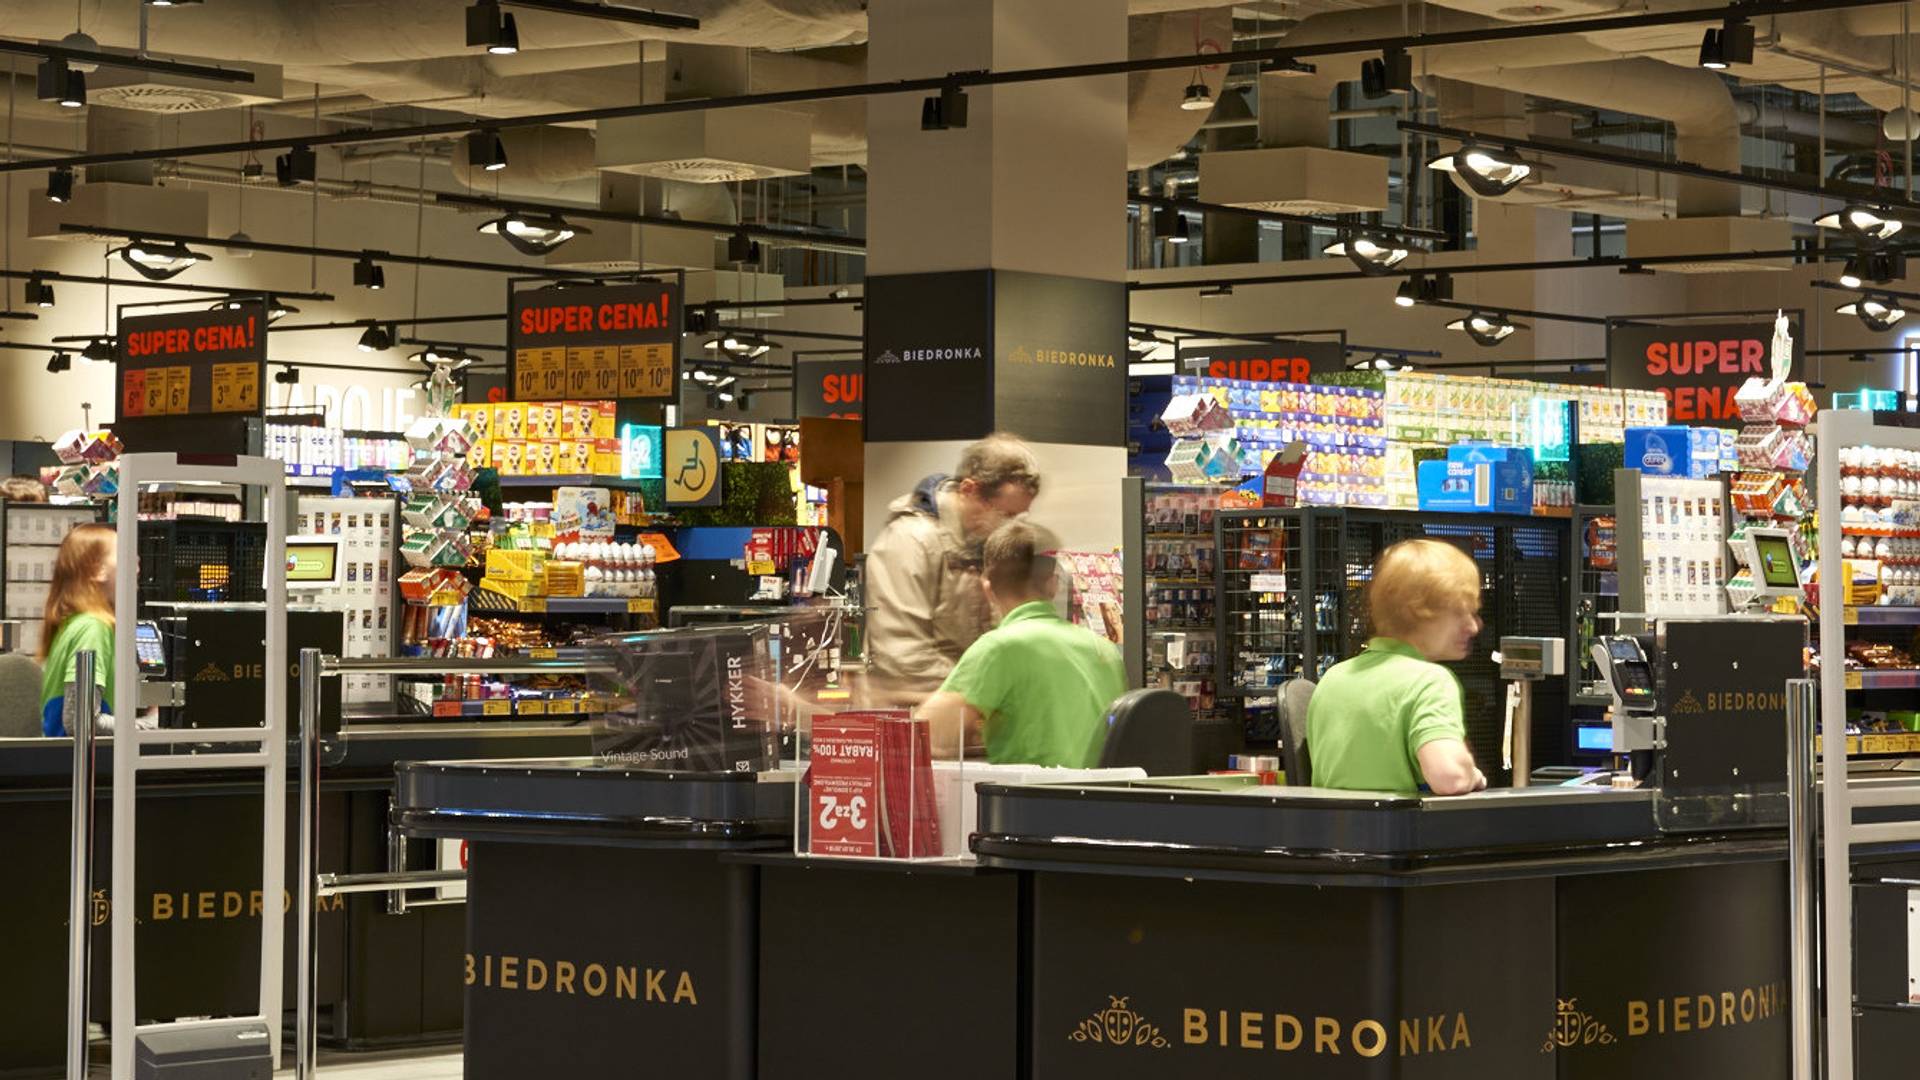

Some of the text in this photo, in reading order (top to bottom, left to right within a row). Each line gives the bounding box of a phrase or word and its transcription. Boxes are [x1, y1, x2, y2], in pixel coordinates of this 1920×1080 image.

[521, 293, 670, 335] SUPER CENA!
[128, 316, 255, 357] SUPER CENA!
[903, 347, 982, 361] BIEDRONKA
[1036, 350, 1115, 368] BIEDRONKA
[1647, 339, 1764, 375] SUPER
[1209, 358, 1310, 384] SUPER
[823, 374, 863, 403] SU
[727, 656, 747, 729] HYKKER
[1707, 692, 1787, 711] BIEDRONK
[601, 747, 688, 764] Vintage Sound
[813, 744, 837, 756] 100%
[839, 744, 873, 758] RABAT
[152, 890, 346, 920] BIEDRKA
[464, 953, 698, 1005] BIEDRONKA
[1183, 1007, 1471, 1057] BIEDRONKA
